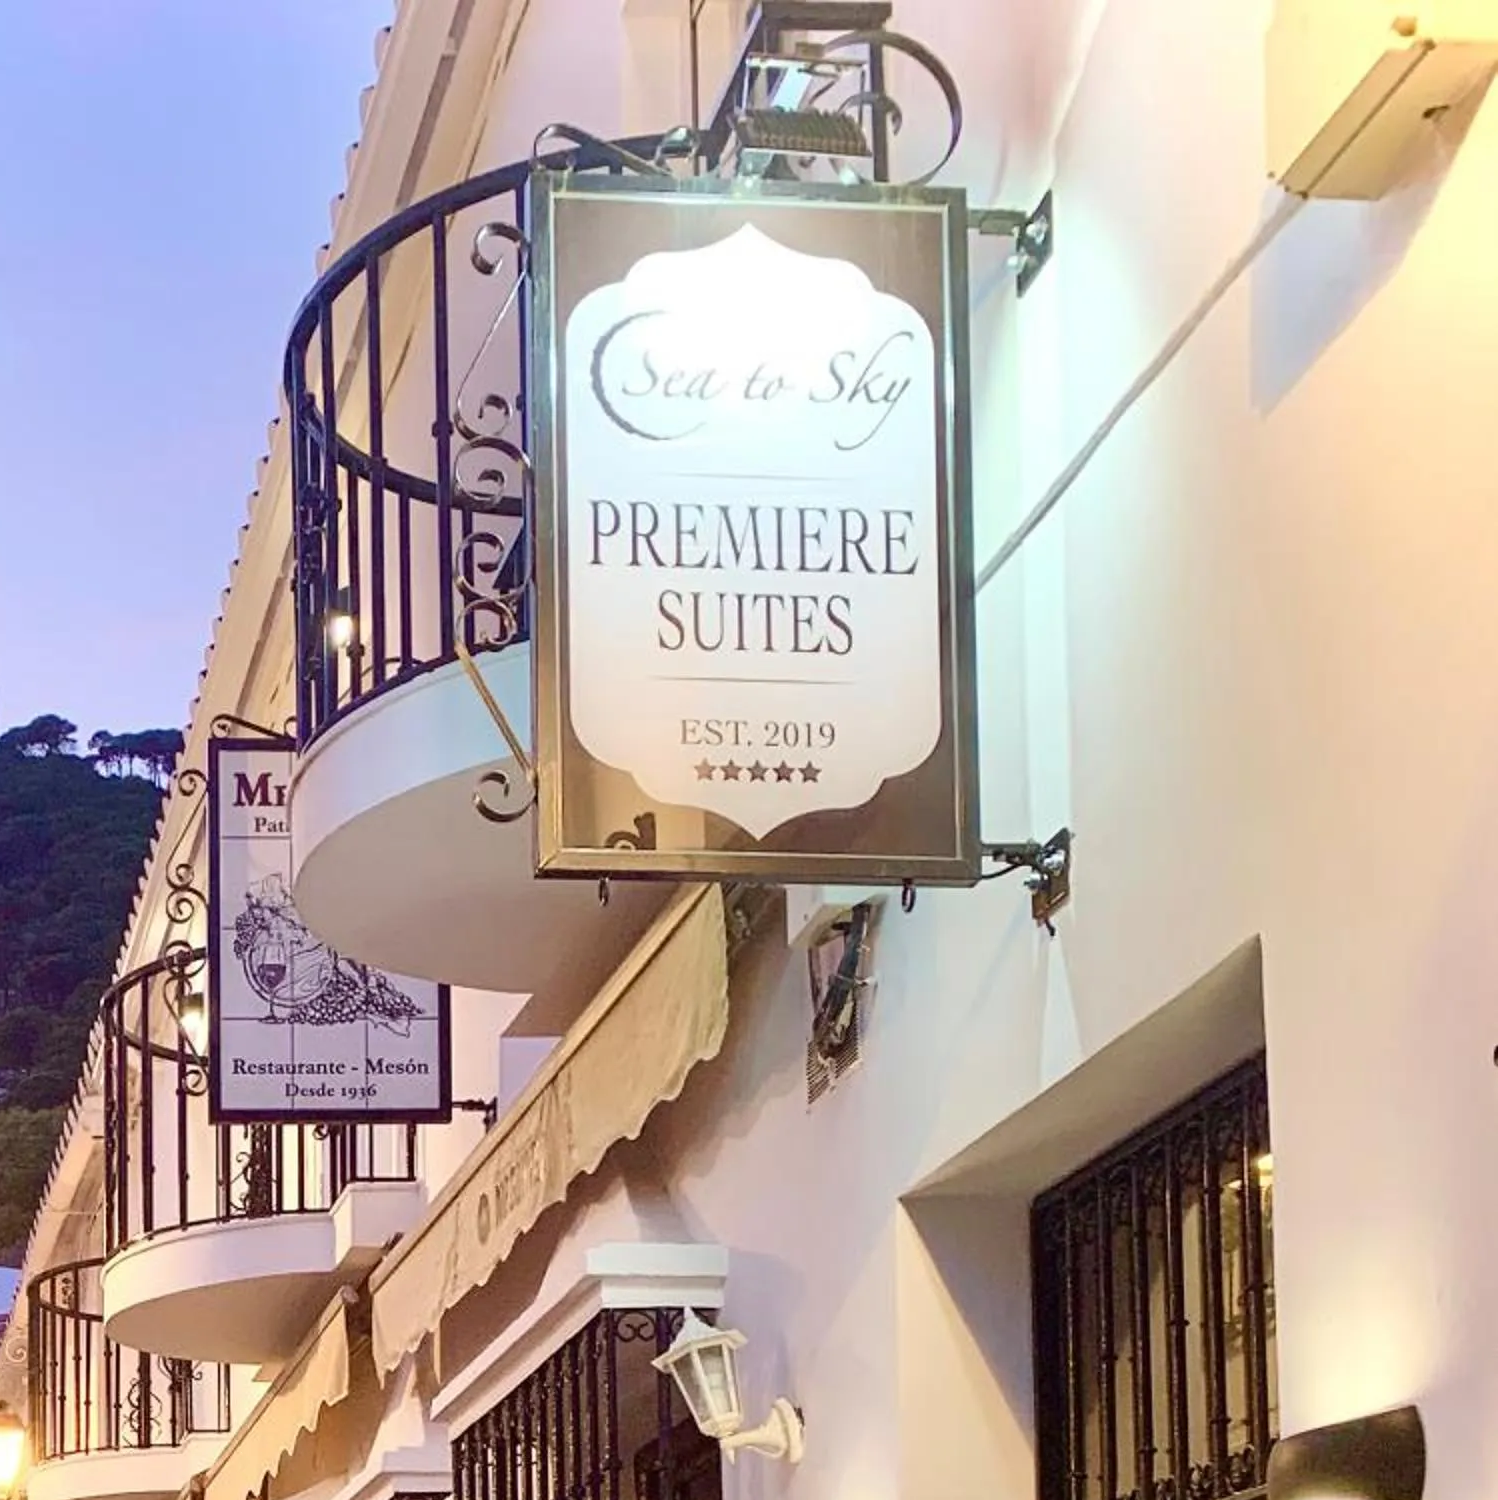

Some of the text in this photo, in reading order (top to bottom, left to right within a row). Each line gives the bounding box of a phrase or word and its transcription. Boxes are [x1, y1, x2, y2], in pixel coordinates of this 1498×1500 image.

[621, 331, 914, 451] Sea to Sky
[589, 499, 919, 575] PREMIERE
[657, 589, 853, 655] SUITES
[680, 719, 836, 748] EST. 2019
[255, 817, 290, 832] Pat
[232, 1058, 346, 1075] Restaurante
[365, 1057, 429, 1075] Mesón
[285, 1082, 377, 1099] Desde 1936
